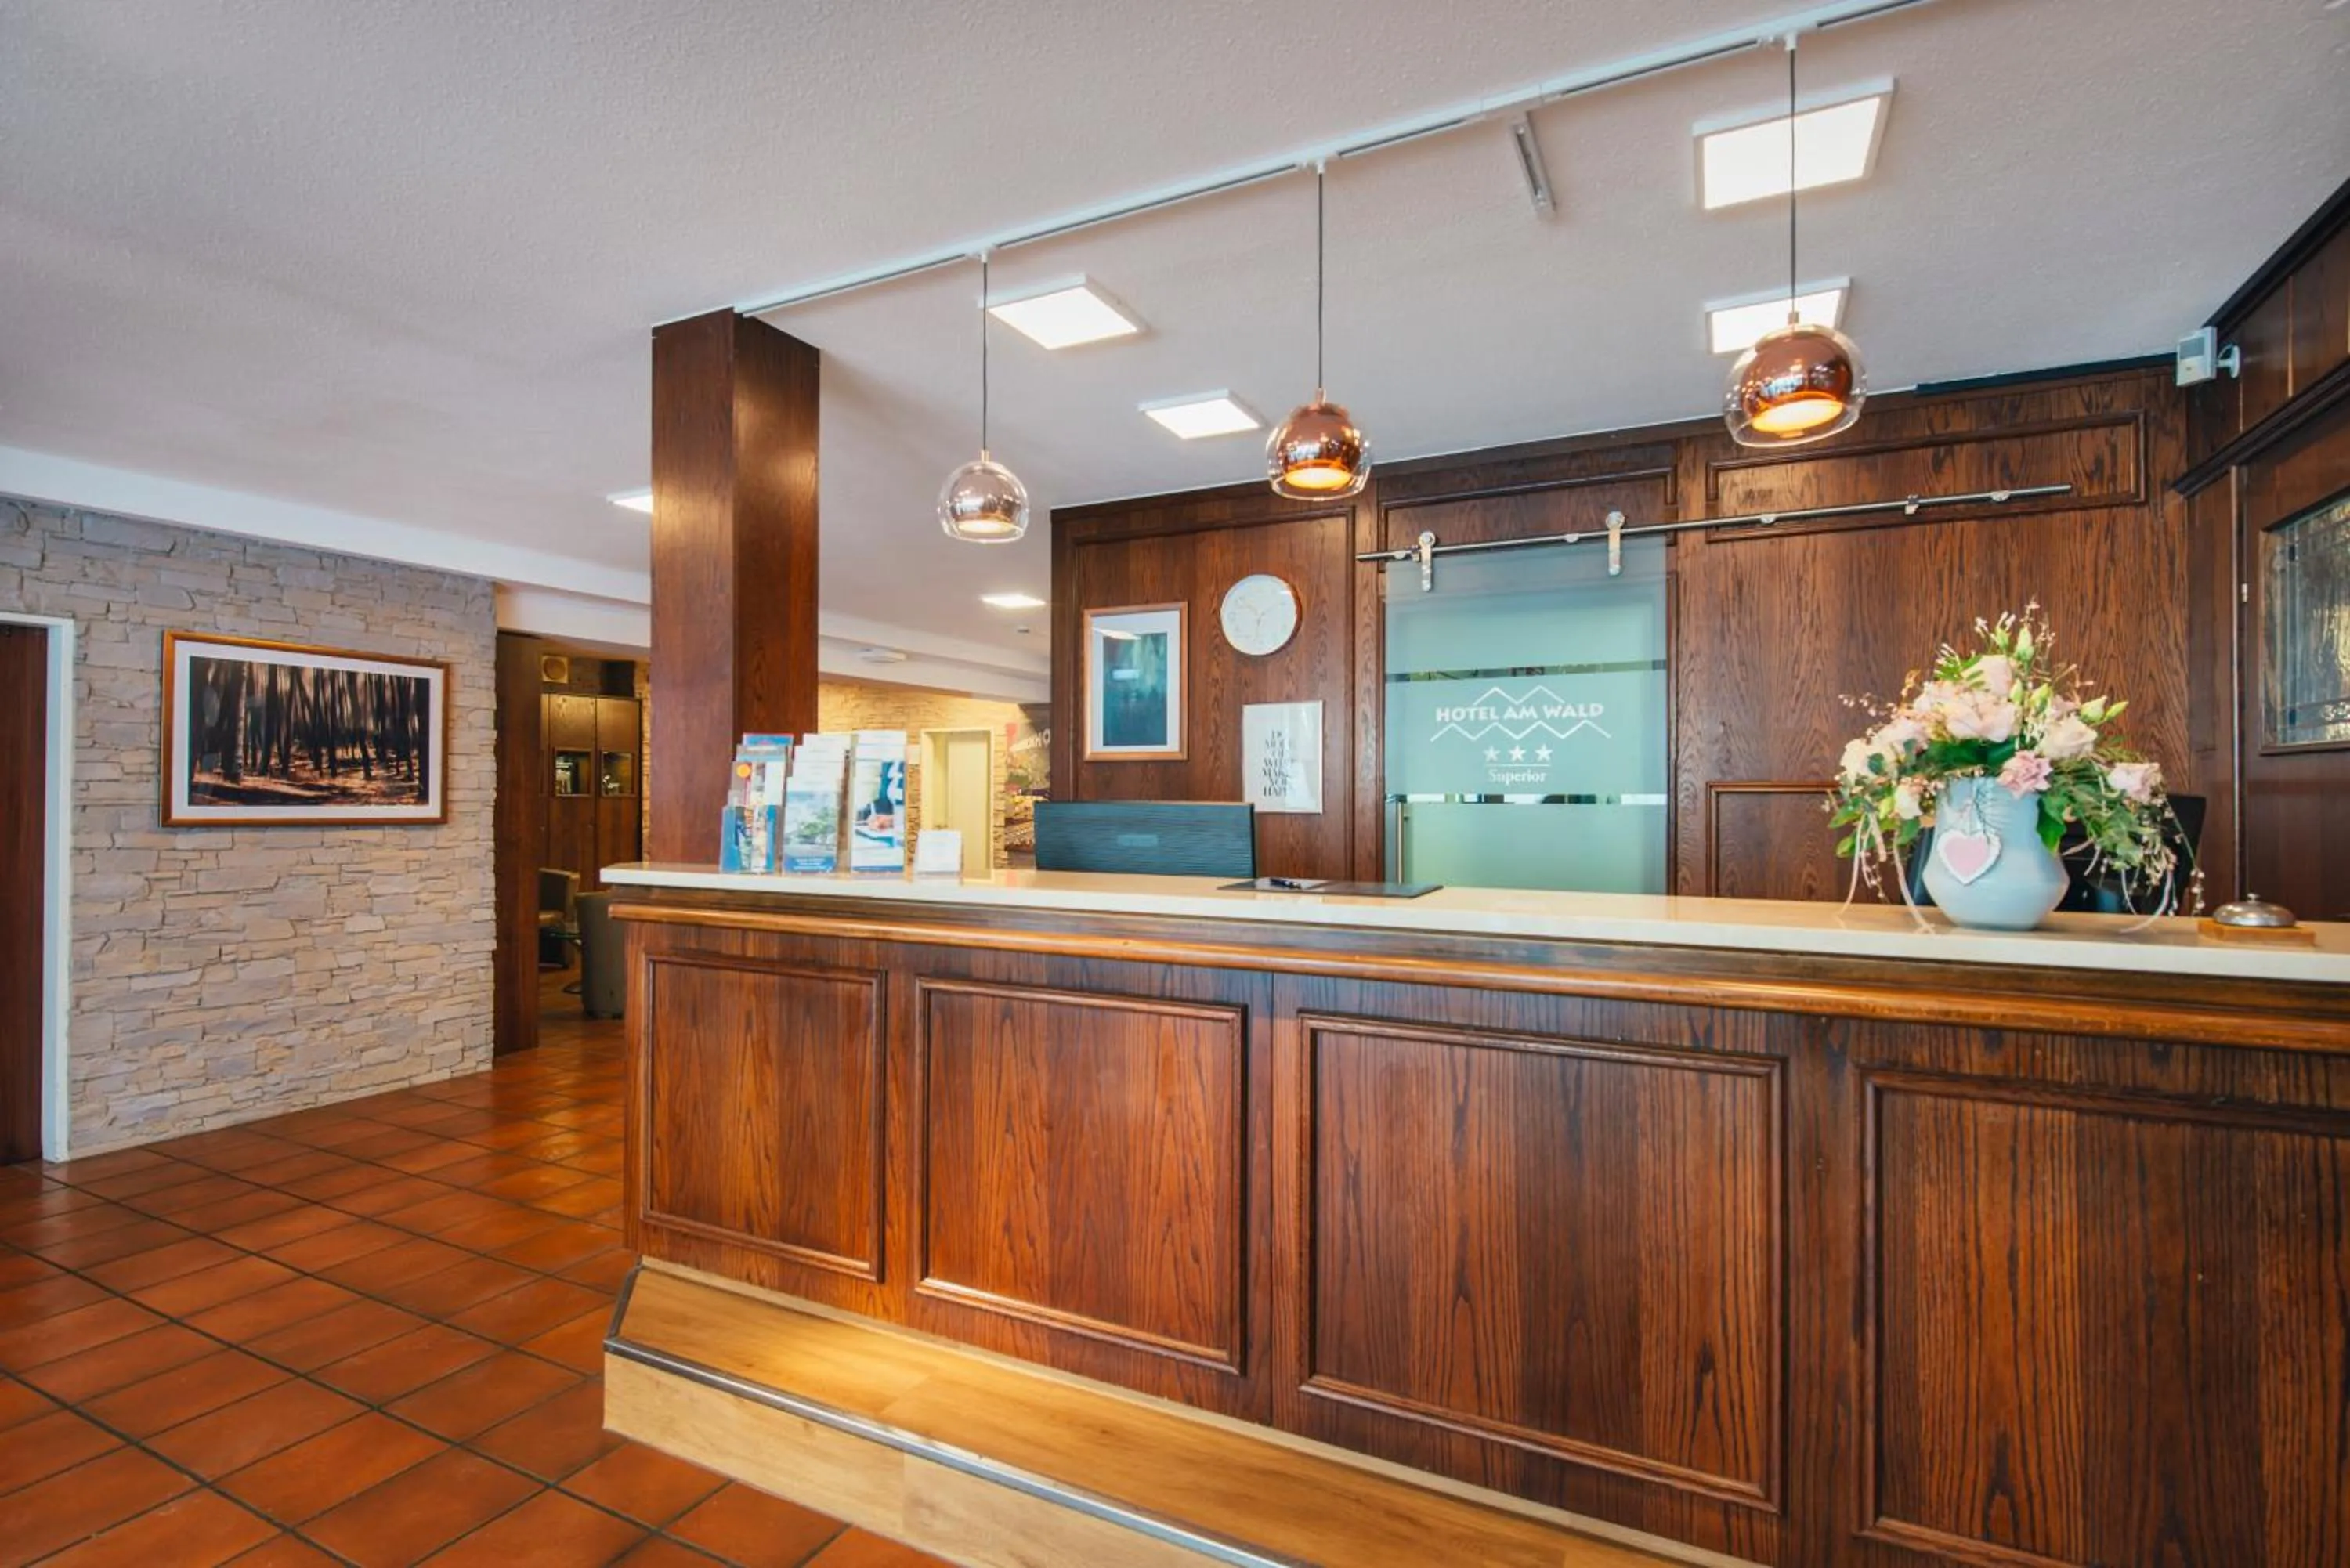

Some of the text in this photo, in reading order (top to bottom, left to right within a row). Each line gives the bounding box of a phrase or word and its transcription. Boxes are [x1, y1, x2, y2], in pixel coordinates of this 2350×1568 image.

[1436, 703, 1604, 722] HOTEL AM WALD
[1488, 769, 1547, 785] Superior
